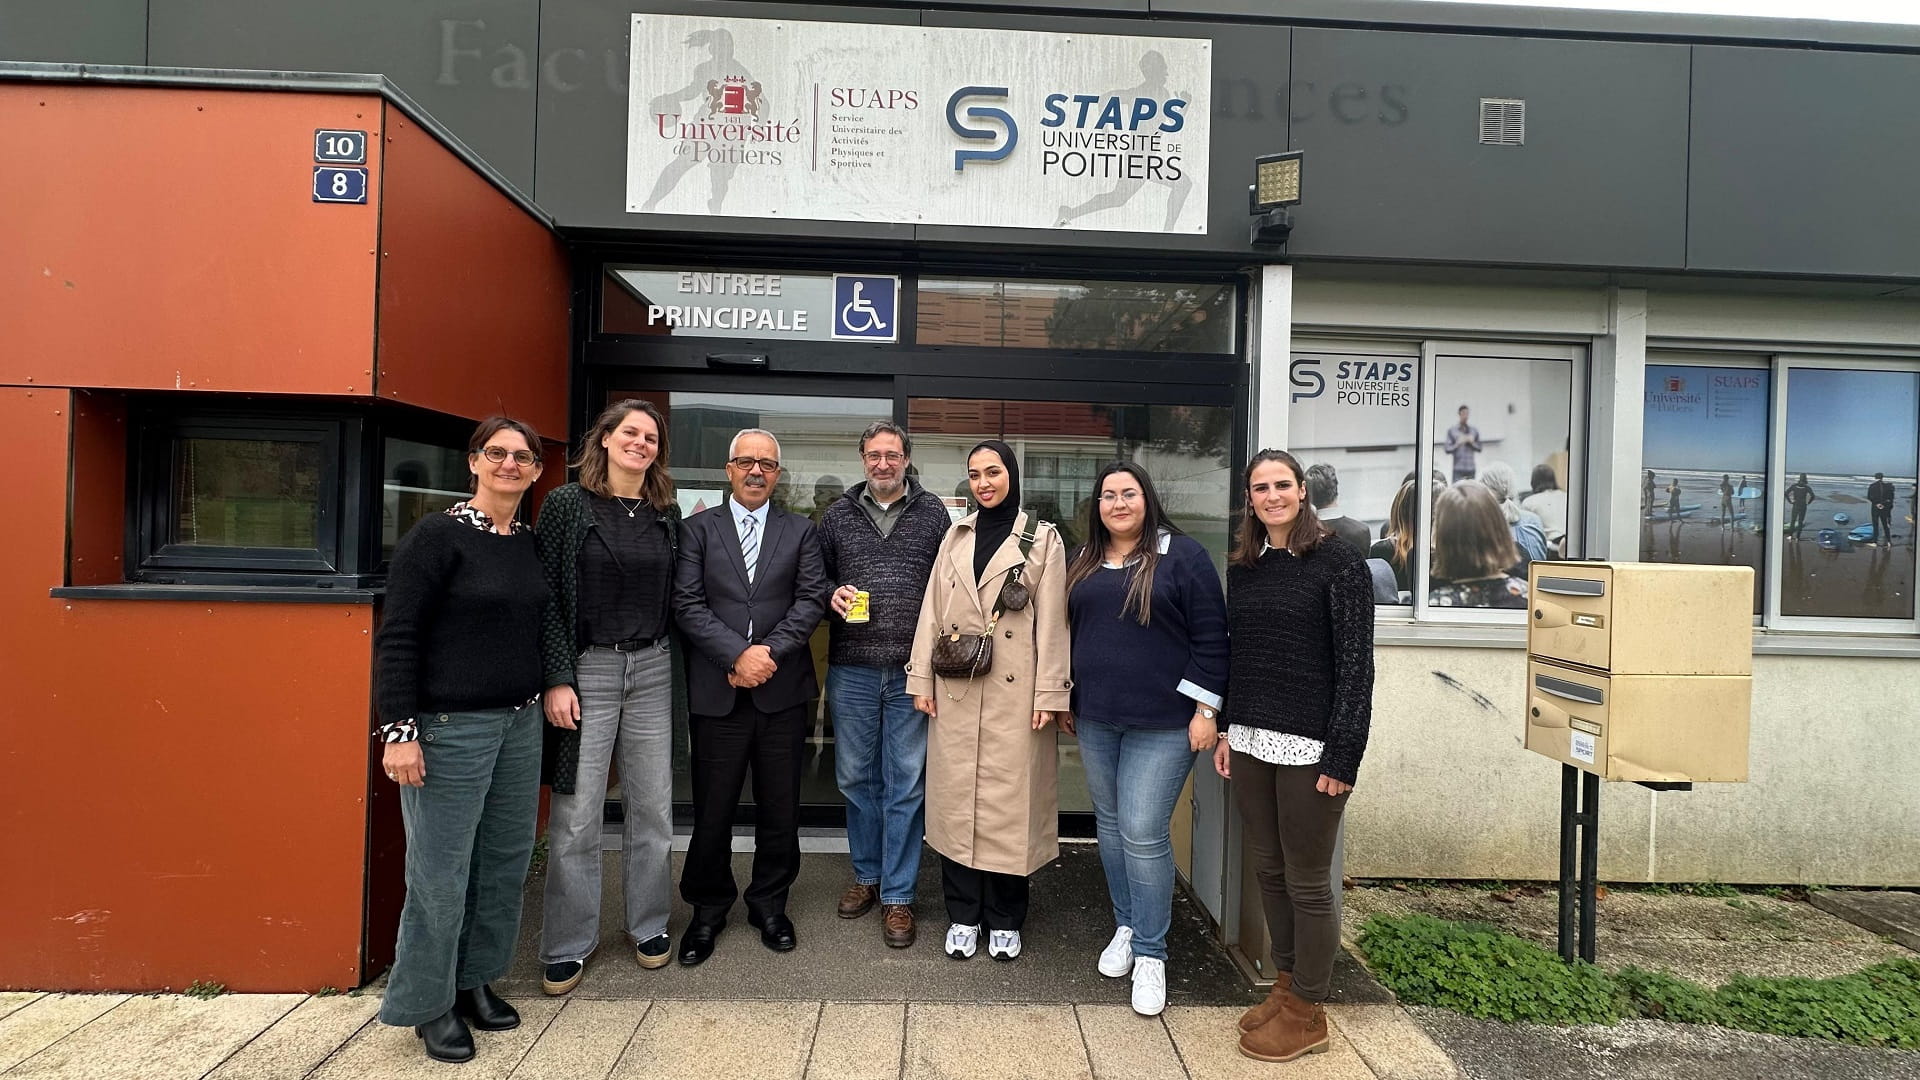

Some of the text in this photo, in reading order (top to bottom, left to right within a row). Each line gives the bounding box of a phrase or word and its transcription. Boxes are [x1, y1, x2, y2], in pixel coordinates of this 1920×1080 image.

[831, 87, 918, 110] SUAPS
[832, 113, 864, 122] Service
[1040, 93, 1187, 133] STAPS
[656, 113, 800, 143] Université
[832, 125, 903, 135] Universitaire des
[325, 136, 354, 156] 10
[831, 136, 869, 145] Activités
[1043, 131, 1182, 153] UNIVERSITÉ DE
[673, 141, 782, 166] de Poitiers
[830, 158, 872, 168] Sportives
[831, 147, 874, 158] Physiques
[1043, 150, 1182, 181] POITIERS
[332, 172, 347, 196] 8
[677, 271, 781, 297] ENTREE
[647, 304, 808, 332] PRINCIPALE
[1336, 360, 1413, 382] STAPS
[1713, 375, 1760, 389] SUAPS
[1337, 380, 1400, 392] UNIVERSITÉ
[1337, 391, 1410, 407] POITIERS
